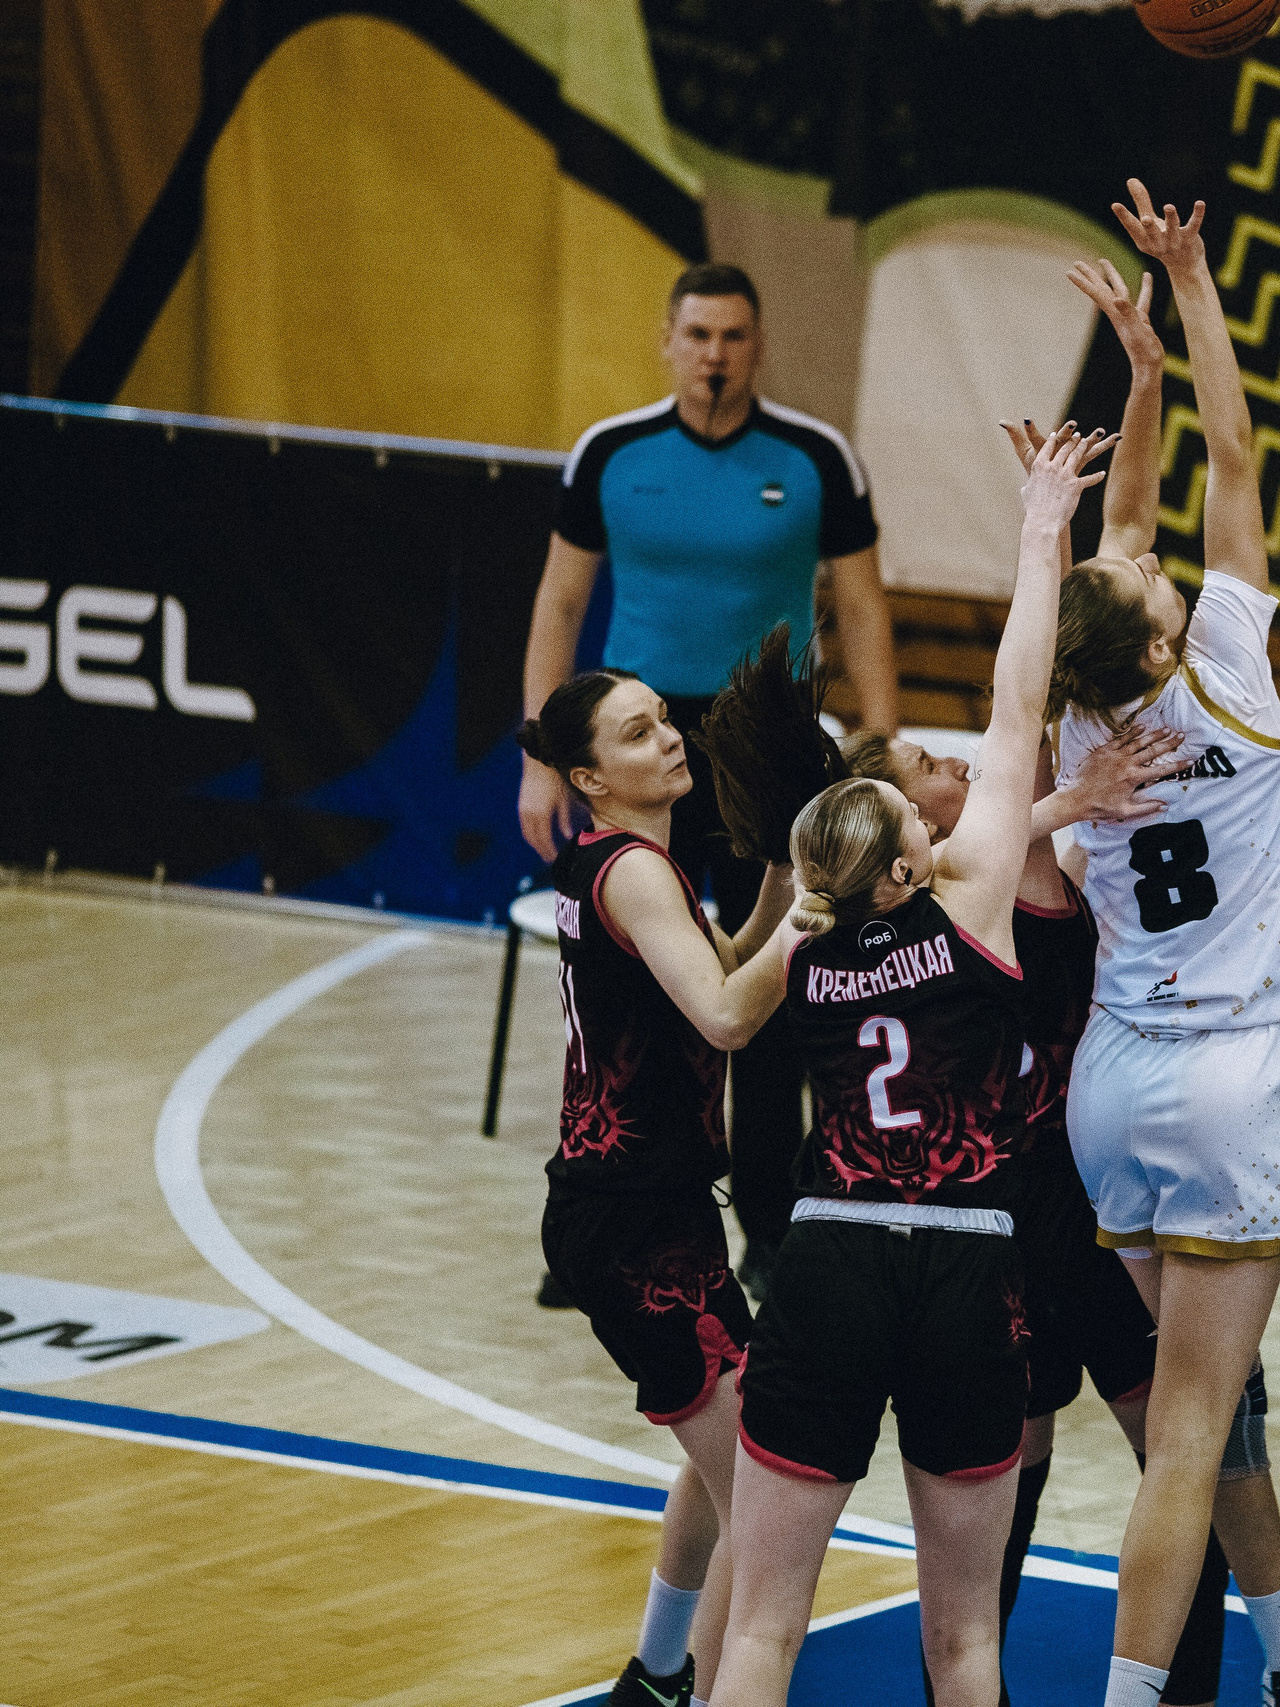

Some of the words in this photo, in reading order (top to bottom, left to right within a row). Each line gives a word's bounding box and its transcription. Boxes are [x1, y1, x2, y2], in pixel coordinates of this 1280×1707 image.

[1128, 819, 1219, 934] 8
[806, 933, 954, 1003] КРЕМЕНЕЦКАЯ
[864, 931, 892, 949] РФБ
[857, 1014, 922, 1129] 2
